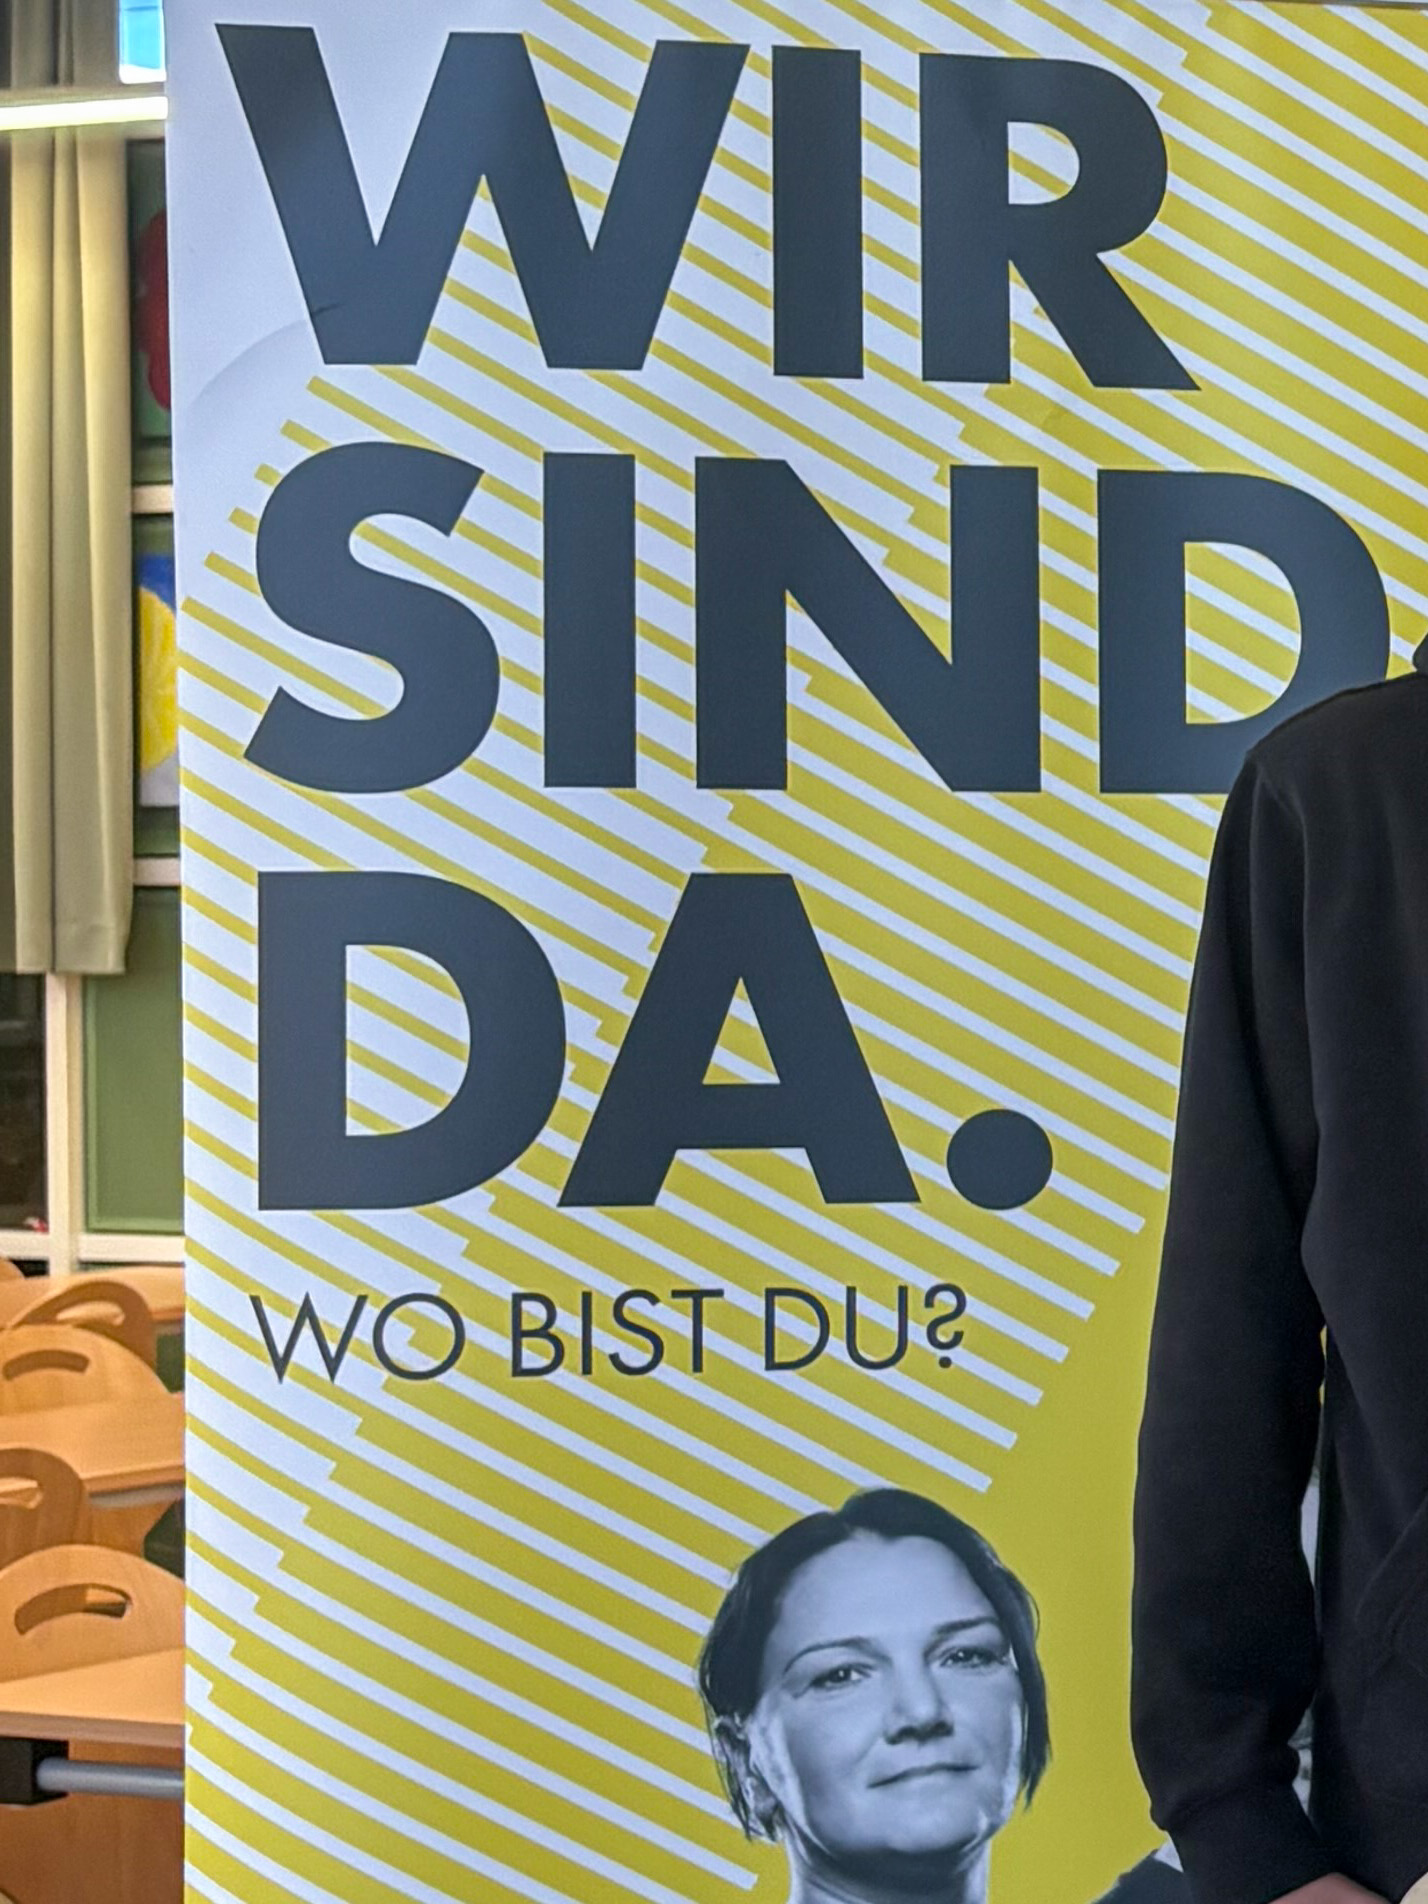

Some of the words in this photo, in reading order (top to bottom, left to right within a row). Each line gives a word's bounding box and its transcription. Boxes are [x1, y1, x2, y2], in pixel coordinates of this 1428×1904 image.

[214, 23, 1200, 391] WIR
[243, 440, 1391, 794] SIND
[257, 870, 1054, 1211] DA.
[249, 1291, 466, 1385] WO
[510, 1288, 725, 1378] BIST
[763, 1283, 967, 1372] DU?
